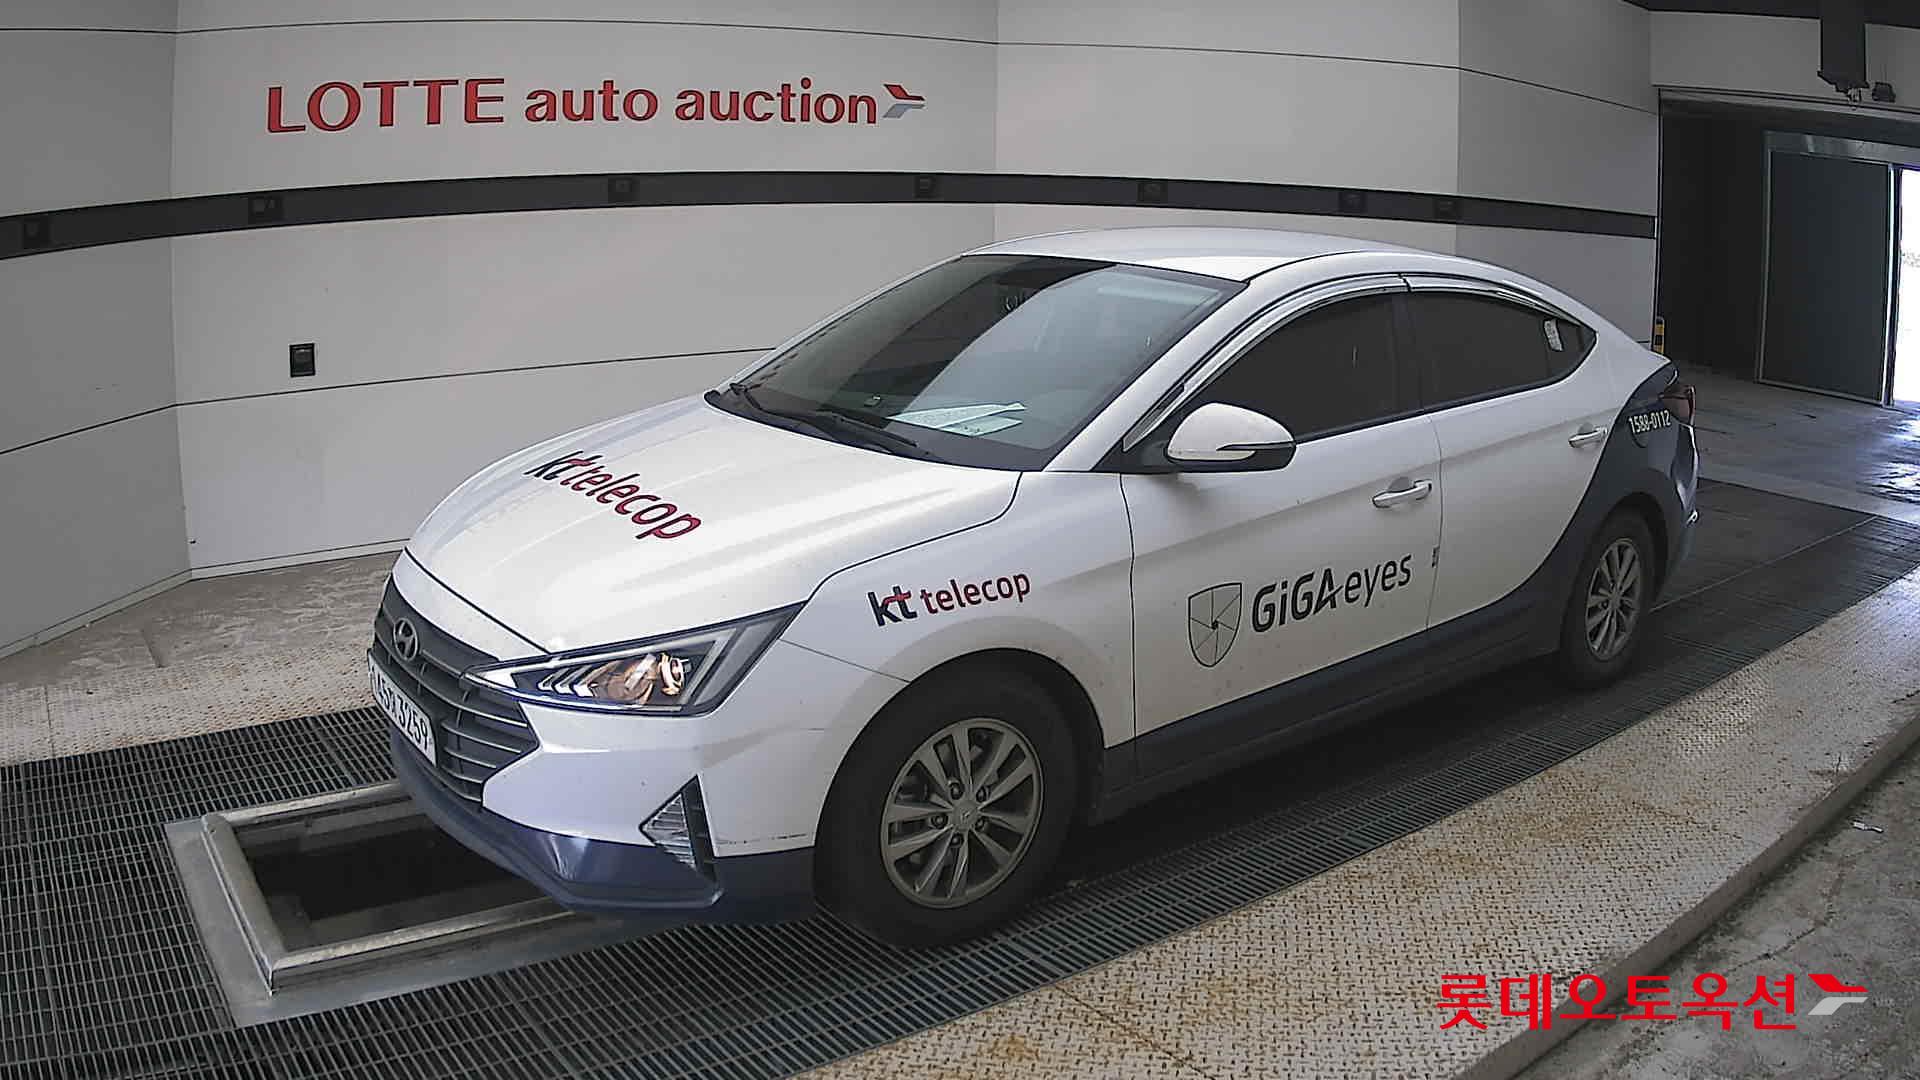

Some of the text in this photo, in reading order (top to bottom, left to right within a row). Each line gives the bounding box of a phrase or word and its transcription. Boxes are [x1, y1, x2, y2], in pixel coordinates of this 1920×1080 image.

[266, 78, 878, 134] LOTTE auto auction
[1628, 409, 1672, 434] 1588-0112
[523, 450, 702, 540] kt telecop
[867, 573, 1031, 627] kt telecop
